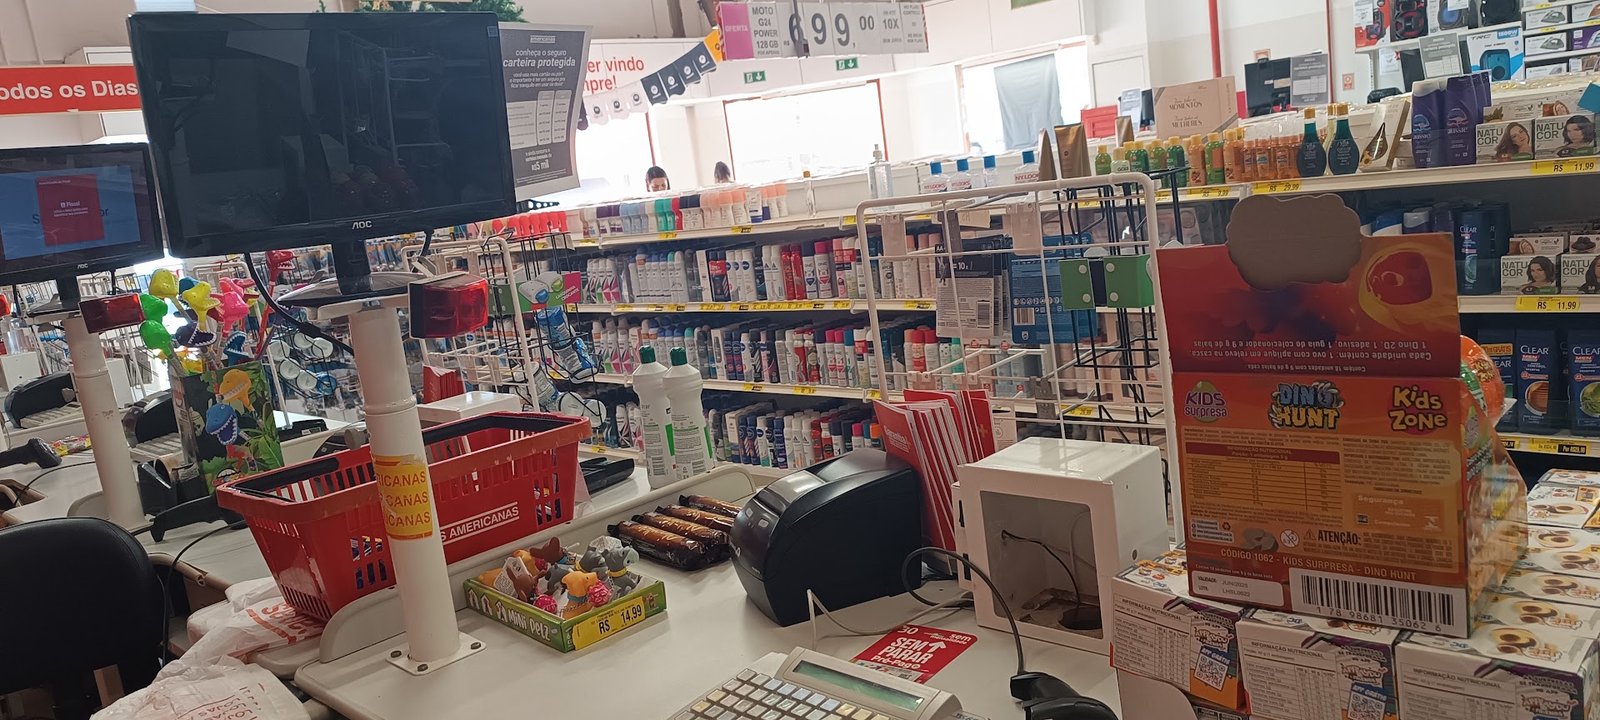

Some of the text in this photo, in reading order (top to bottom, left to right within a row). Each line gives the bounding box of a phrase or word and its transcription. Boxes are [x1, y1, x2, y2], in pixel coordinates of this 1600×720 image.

[752, 6, 774, 15] MOTO
[758, 18, 772, 27] G24
[883, 18, 900, 30] 10X
[754, 30, 778, 38] POWER
[756, 40, 779, 49] 128 GB
[515, 49, 541, 57] conheça
[503, 57, 576, 68] carteira protegida
[586, 57, 645, 72] er vindo
[583, 75, 617, 95] mpre!
[0, 80, 139, 101] odos os Dias
[1536, 122, 1565, 132] NATU
[1476, 128, 1504, 138] NATU
[1536, 130, 1559, 140] COR
[1477, 137, 1499, 146] COR
[352, 220, 373, 230] AOC
[1460, 225, 1478, 233] CLEAR
[1502, 261, 1530, 270] NATU
[1562, 259, 1590, 268] NATU
[1502, 268, 1524, 277] COR
[1562, 267, 1585, 276] COR
[1245, 340, 1293, 348] colecionador
[1308, 340, 1325, 349] guia
[1398, 341, 1418, 349] Dino
[1225, 350, 1247, 358] relevo
[1264, 349, 1291, 358] aplique
[1520, 345, 1549, 355] CLEAR
[1372, 352, 1406, 360] unidade
[1409, 352, 1431, 360] Cada
[1495, 360, 1512, 368] EAR
[1185, 391, 1226, 406] KIDS
[1277, 383, 1337, 409] DINO
[1392, 385, 1443, 410] Kids
[1184, 406, 1228, 418] surpresa
[1276, 405, 1339, 430] HUNT
[376, 470, 426, 487] RICANAS
[385, 490, 429, 508] CANAS
[385, 511, 431, 527] ICANAS
[449, 506, 520, 539] AMERICANAS
[1318, 528, 1362, 545] ATENÇÃO:
[1220, 547, 1252, 560] CÓDIGO
[1254, 552, 1275, 563] 1062
[1282, 556, 1304, 567] KIDS
[1305, 559, 1355, 573] SURPRESA
[1364, 566, 1388, 577] DINO
[1390, 570, 1417, 581] HUNT
[1122, 598, 1153, 613] INFORMAÇÃO
[1151, 607, 1182, 621] NUTRICIONAL
[1329, 607, 1342, 617] 78
[1349, 611, 1383, 623] 98681
[1391, 618, 1427, 630] 35062
[950, 633, 972, 642] sem
[890, 637, 931, 649] SEM
[878, 645, 934, 664] PARAR
[1251, 641, 1287, 652] INFORMAÇÃO
[1287, 646, 1324, 659] NUTRICIONAL
[870, 655, 921, 670] Pré-Pago
[1413, 667, 1457, 680] INFORMAÇÃO
[1456, 675, 1501, 689] NUTRICIONAL
